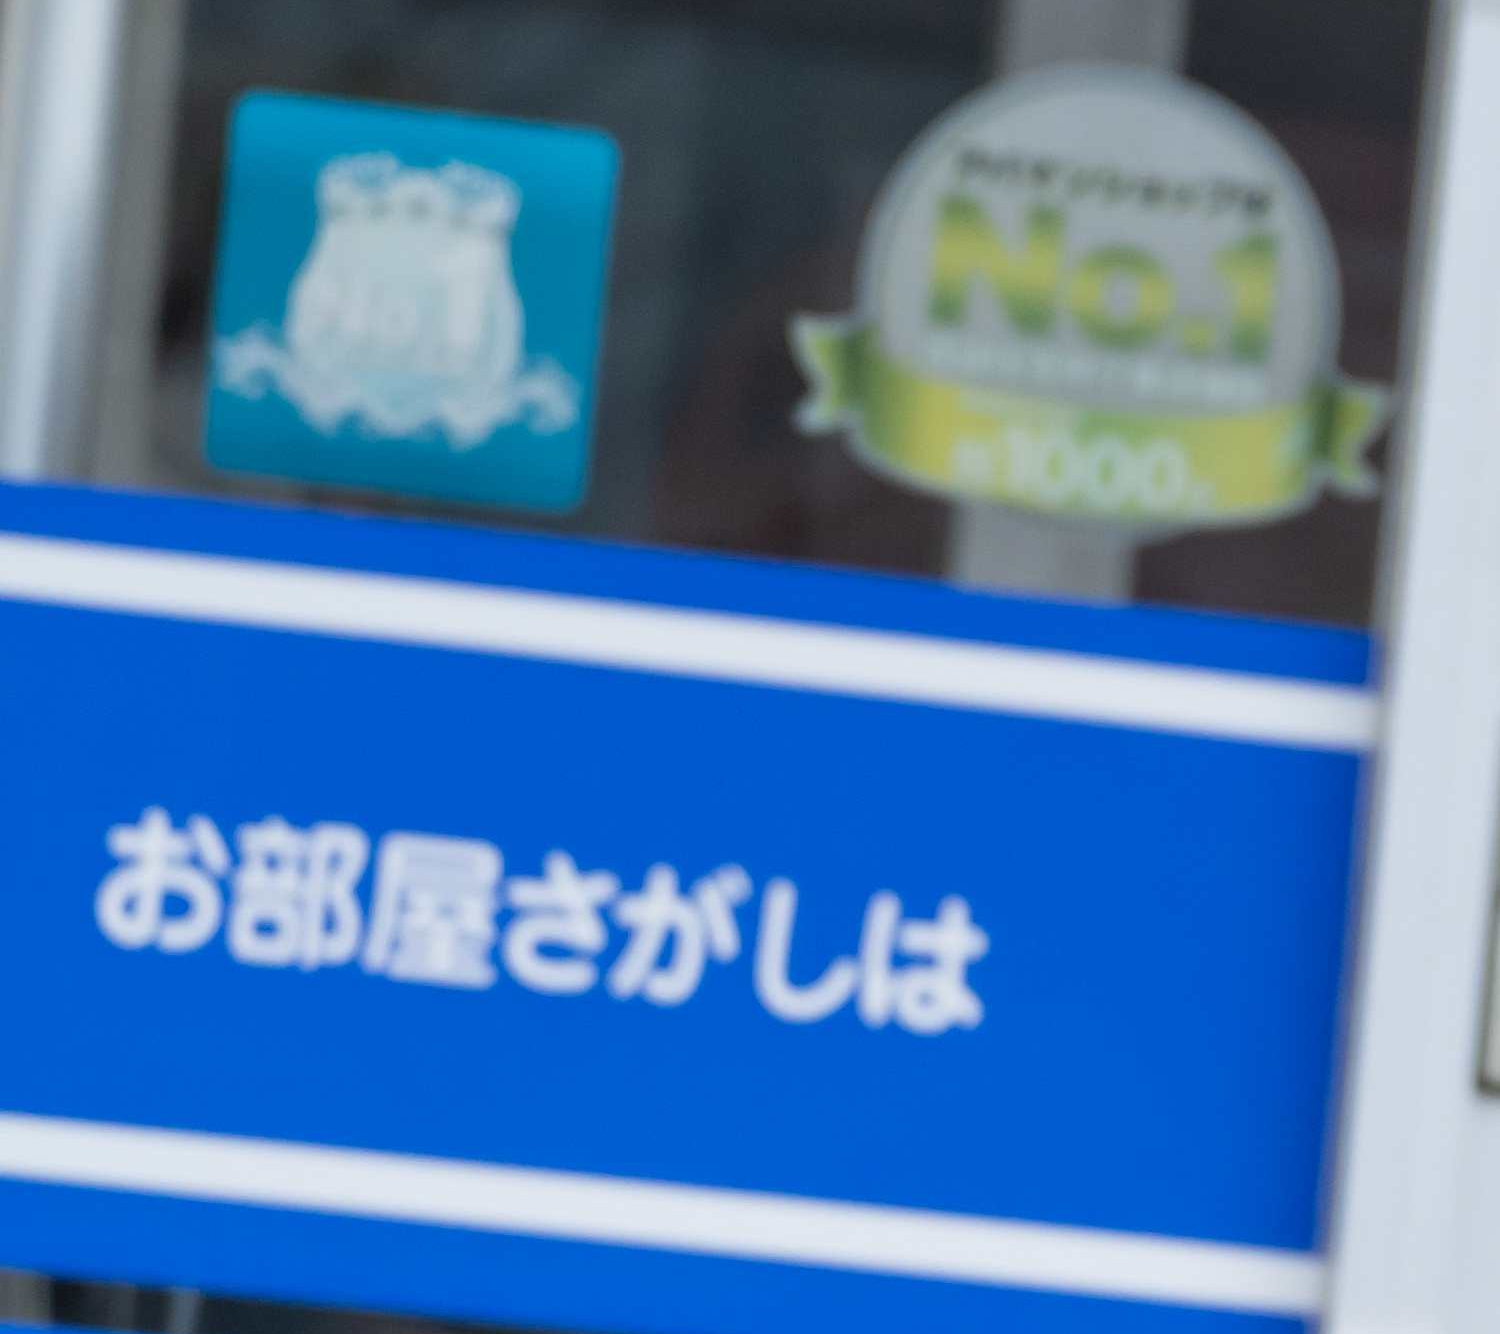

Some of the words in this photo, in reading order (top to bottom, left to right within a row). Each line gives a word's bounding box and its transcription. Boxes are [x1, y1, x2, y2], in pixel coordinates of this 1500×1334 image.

[928, 187, 1278, 365] No.1
[97, 808, 988, 1034] お部屋さがしは
